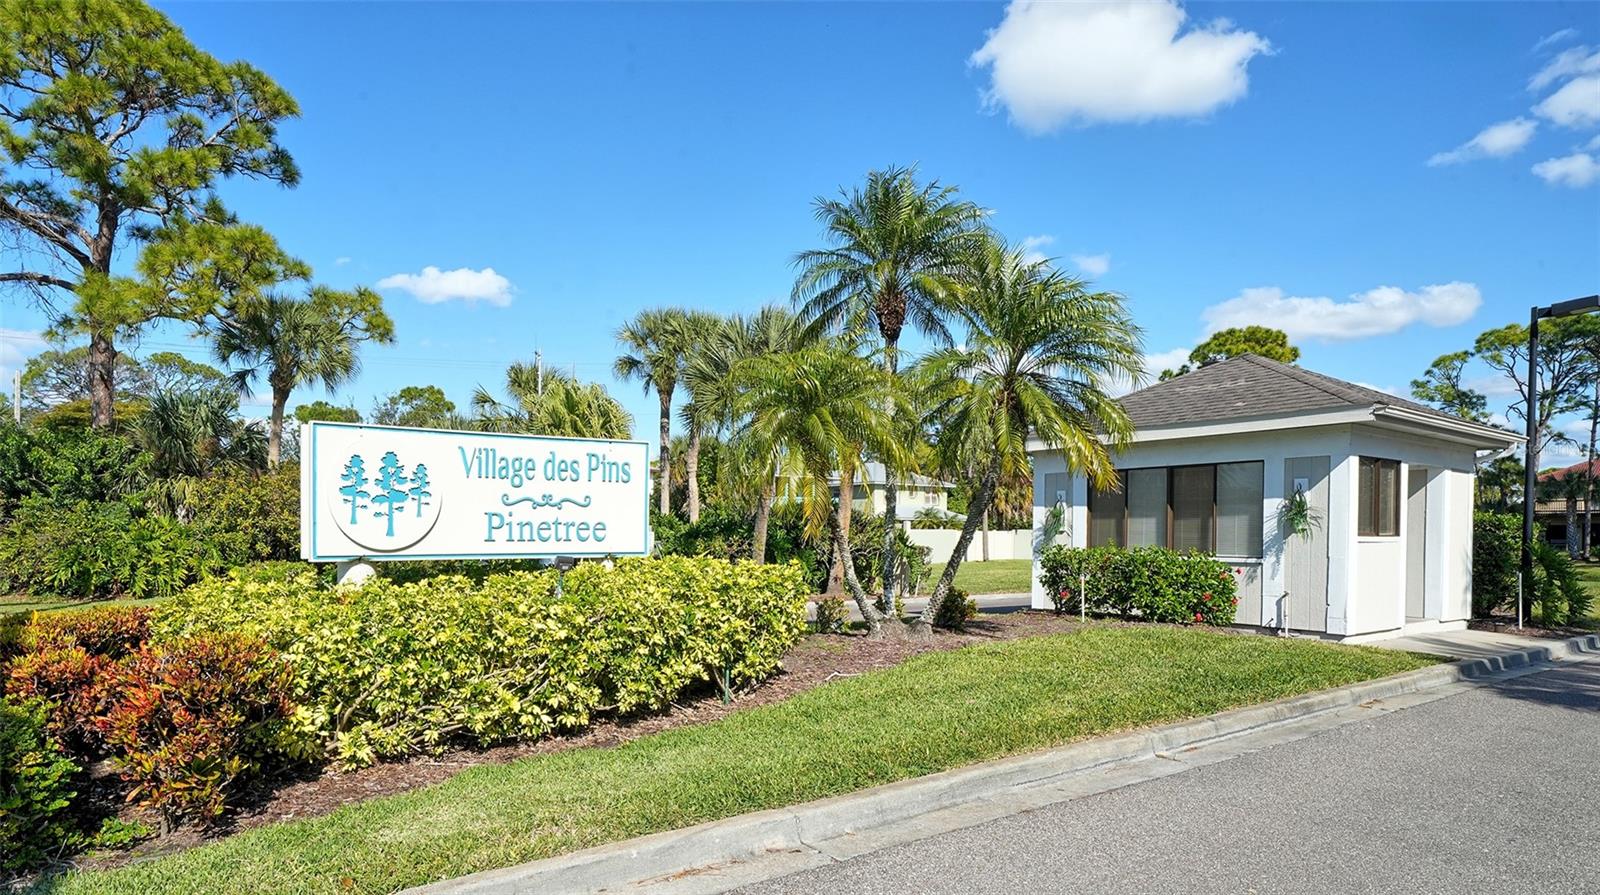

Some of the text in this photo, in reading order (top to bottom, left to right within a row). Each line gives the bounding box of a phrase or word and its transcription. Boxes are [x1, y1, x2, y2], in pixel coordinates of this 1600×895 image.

[458, 446, 630, 488] Village des Pins
[484, 511, 606, 542] Pinetree
